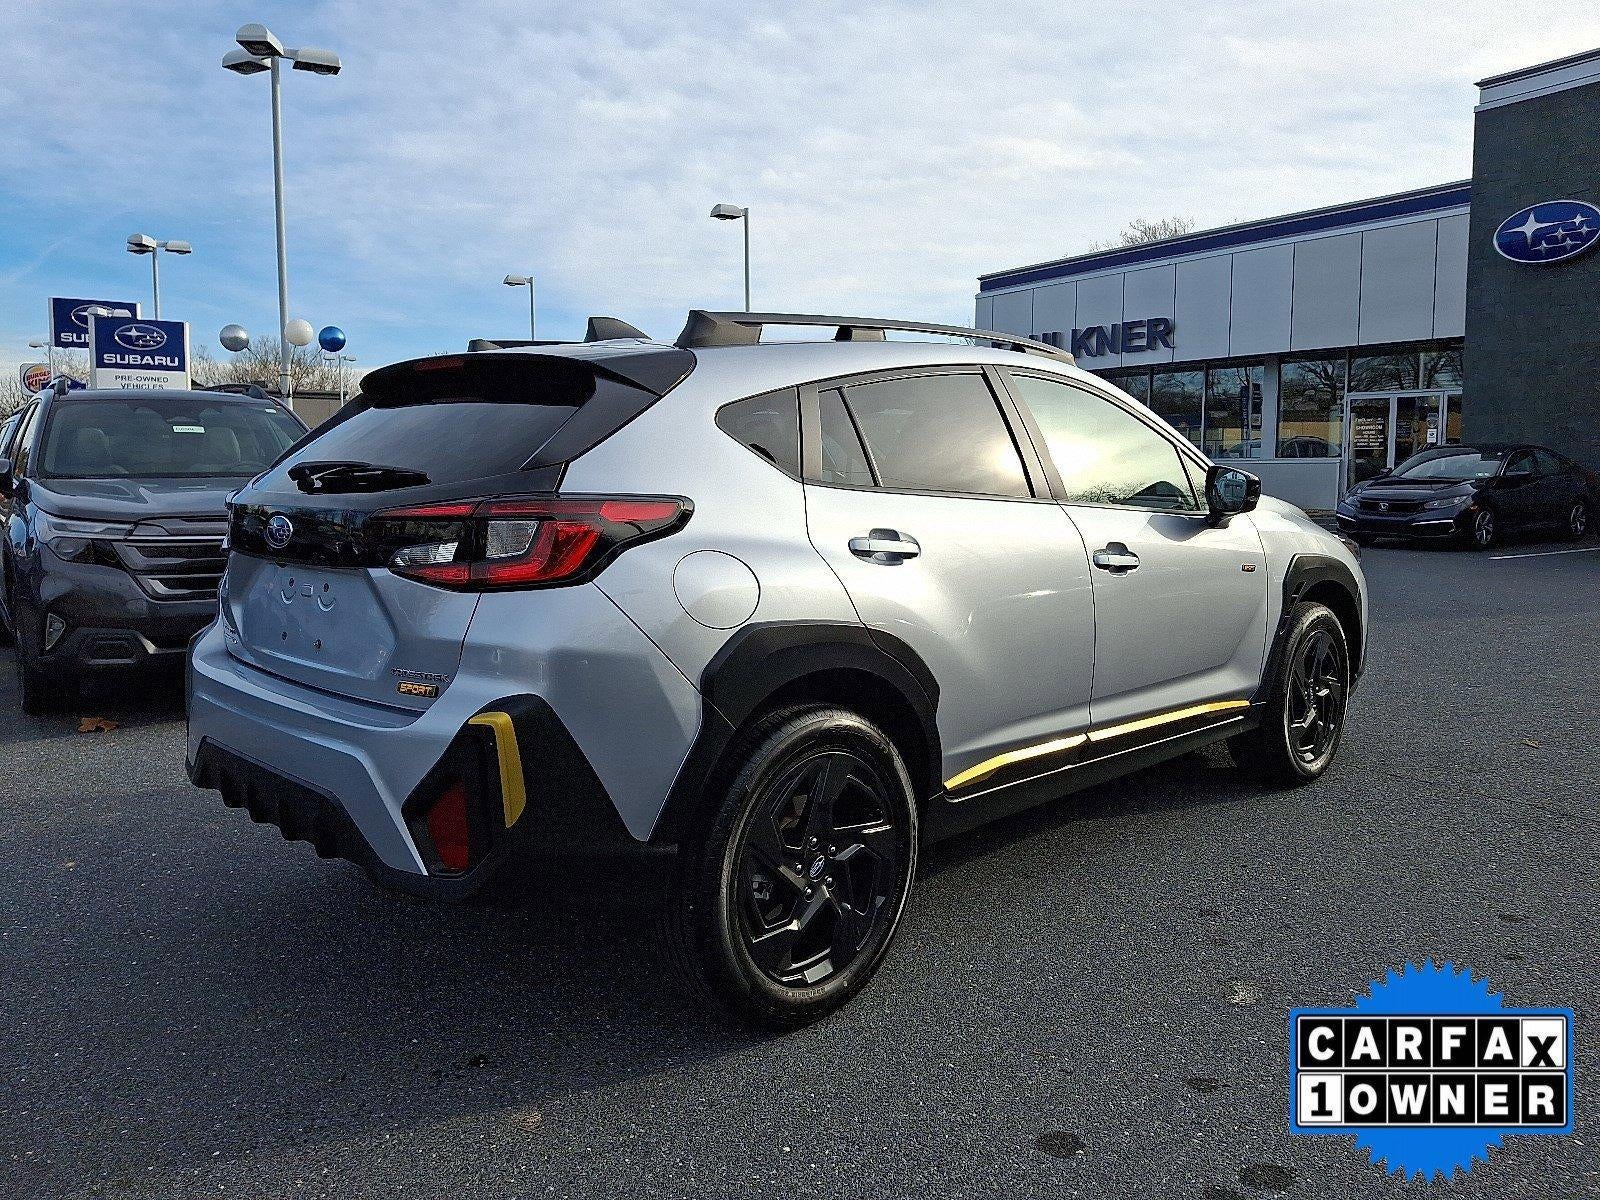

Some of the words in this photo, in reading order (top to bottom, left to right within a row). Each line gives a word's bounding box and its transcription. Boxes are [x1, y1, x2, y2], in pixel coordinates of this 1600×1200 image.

[103, 353, 179, 367] SUBARU
[115, 374, 168, 383] PRE-OWNED
[400, 683, 433, 695] SPORT
